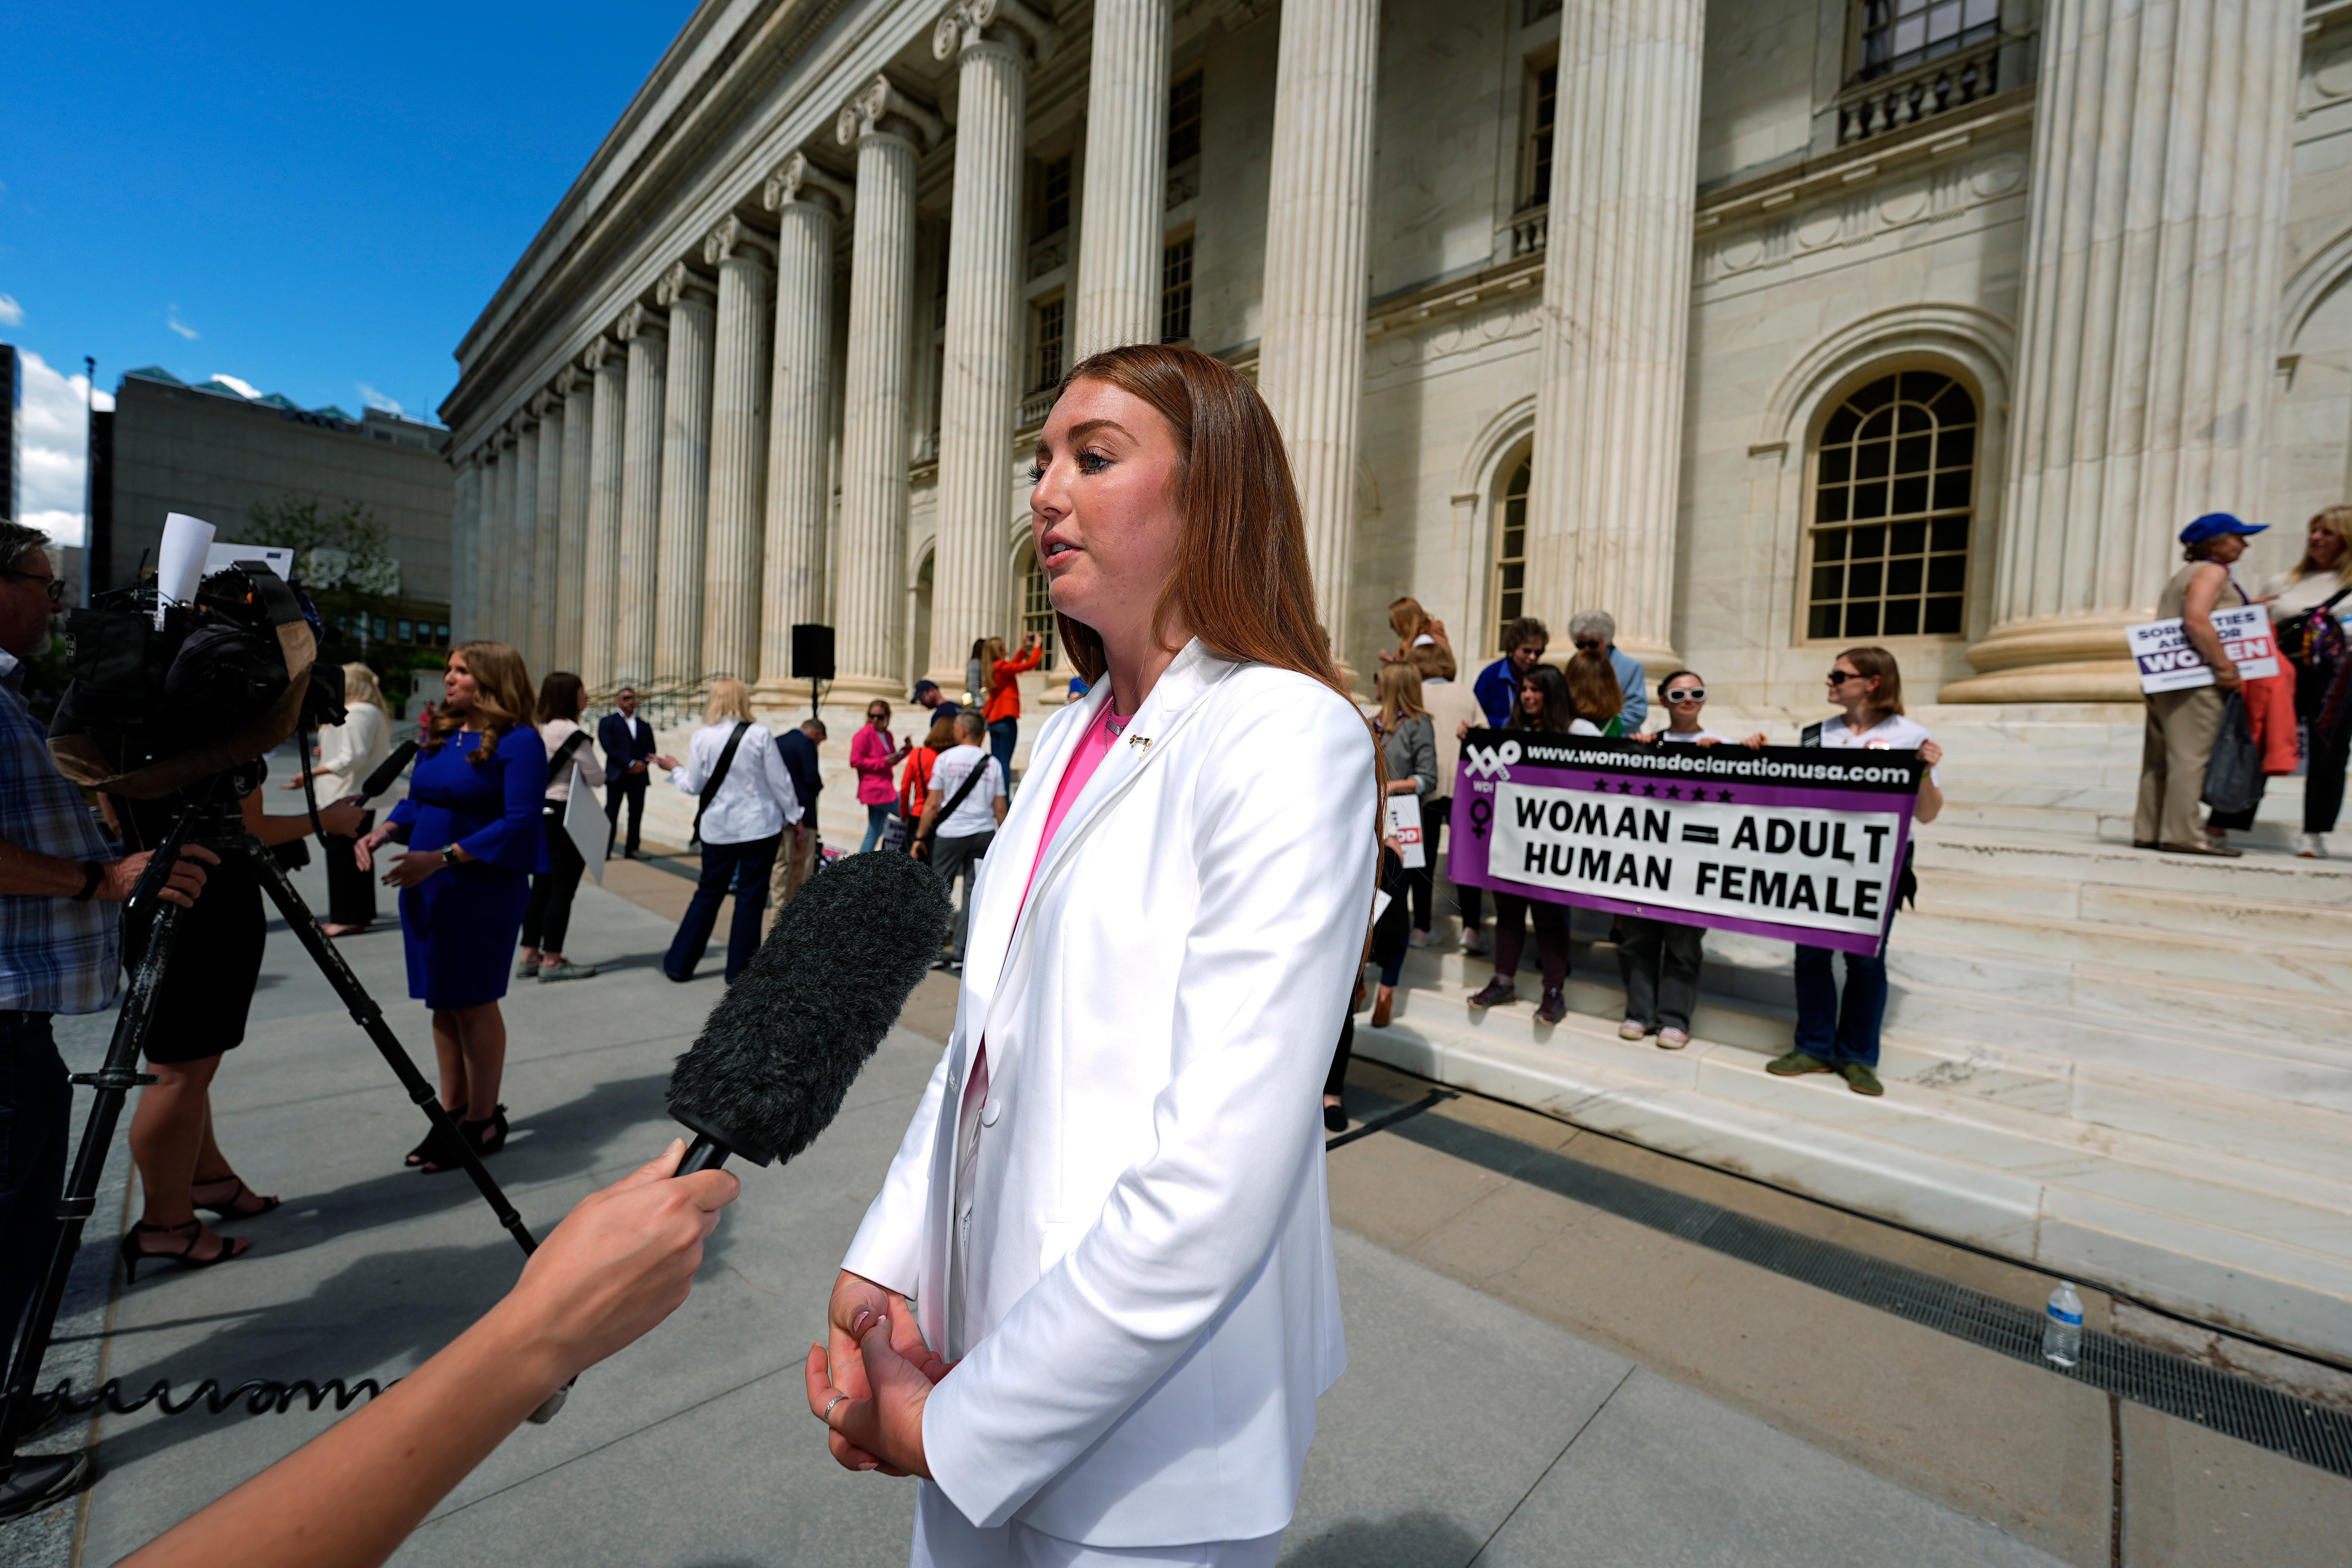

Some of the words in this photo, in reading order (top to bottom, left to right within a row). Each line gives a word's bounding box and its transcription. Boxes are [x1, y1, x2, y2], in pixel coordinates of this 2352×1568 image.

[2138, 612, 2256, 640] SORTIES
[2142, 639, 2268, 673] WOEN
[1527, 746, 1910, 784] www.womensdeclarationusa.com
[1515, 796, 1670, 843] WOMAN
[1682, 824, 1719, 845] =
[1731, 815, 1889, 863] ADULT
[1524, 842, 1672, 891] HUMAN
[1696, 862, 1881, 920] FEMALE
